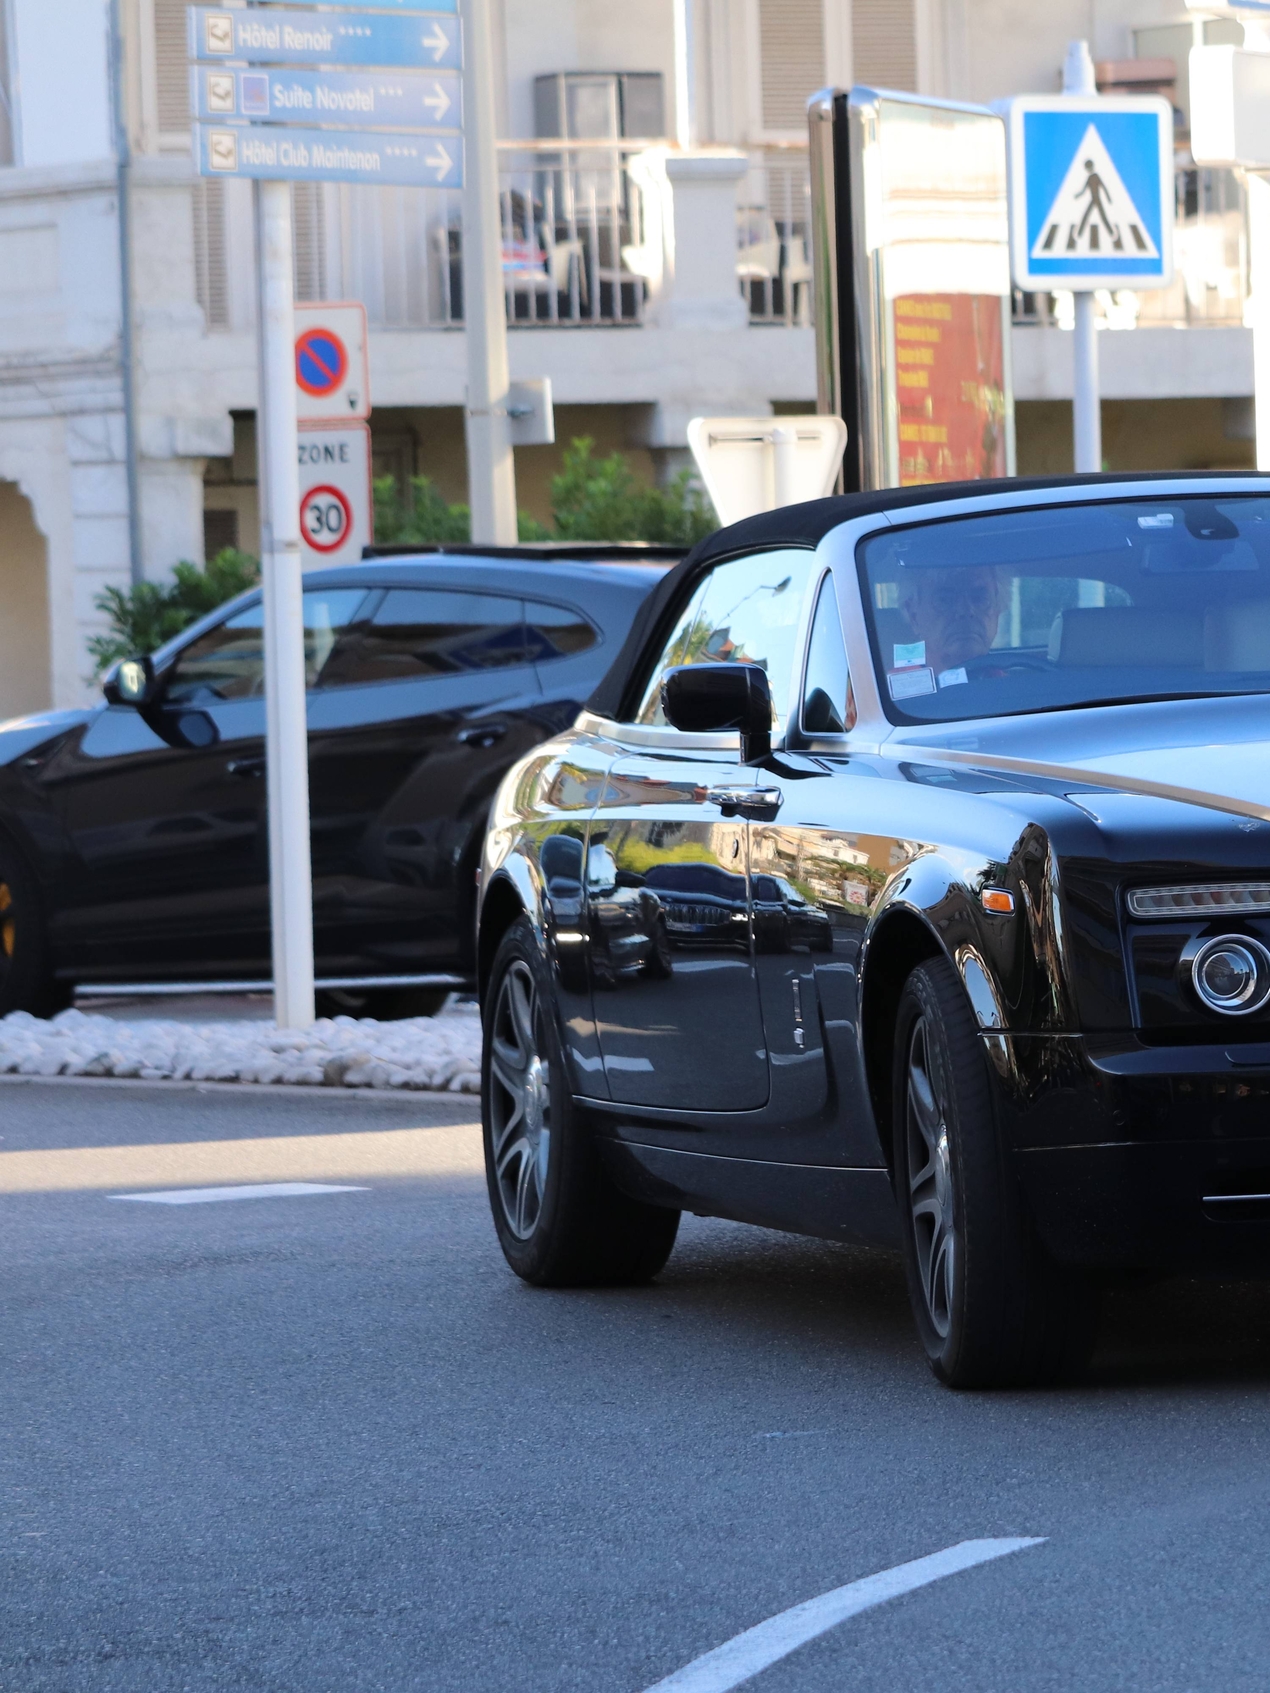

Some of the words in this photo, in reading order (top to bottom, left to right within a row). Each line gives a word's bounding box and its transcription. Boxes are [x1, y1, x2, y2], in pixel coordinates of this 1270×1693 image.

[238, 21, 280, 48] Hôtel
[284, 26, 333, 51] Renoir
[273, 83, 312, 108] Suite
[316, 86, 374, 112] Novotel
[241, 141, 278, 166] Hôtel
[280, 143, 309, 167] Club
[312, 146, 381, 171] Maintenon
[298, 443, 350, 465] ZONE
[308, 503, 343, 535] 30
